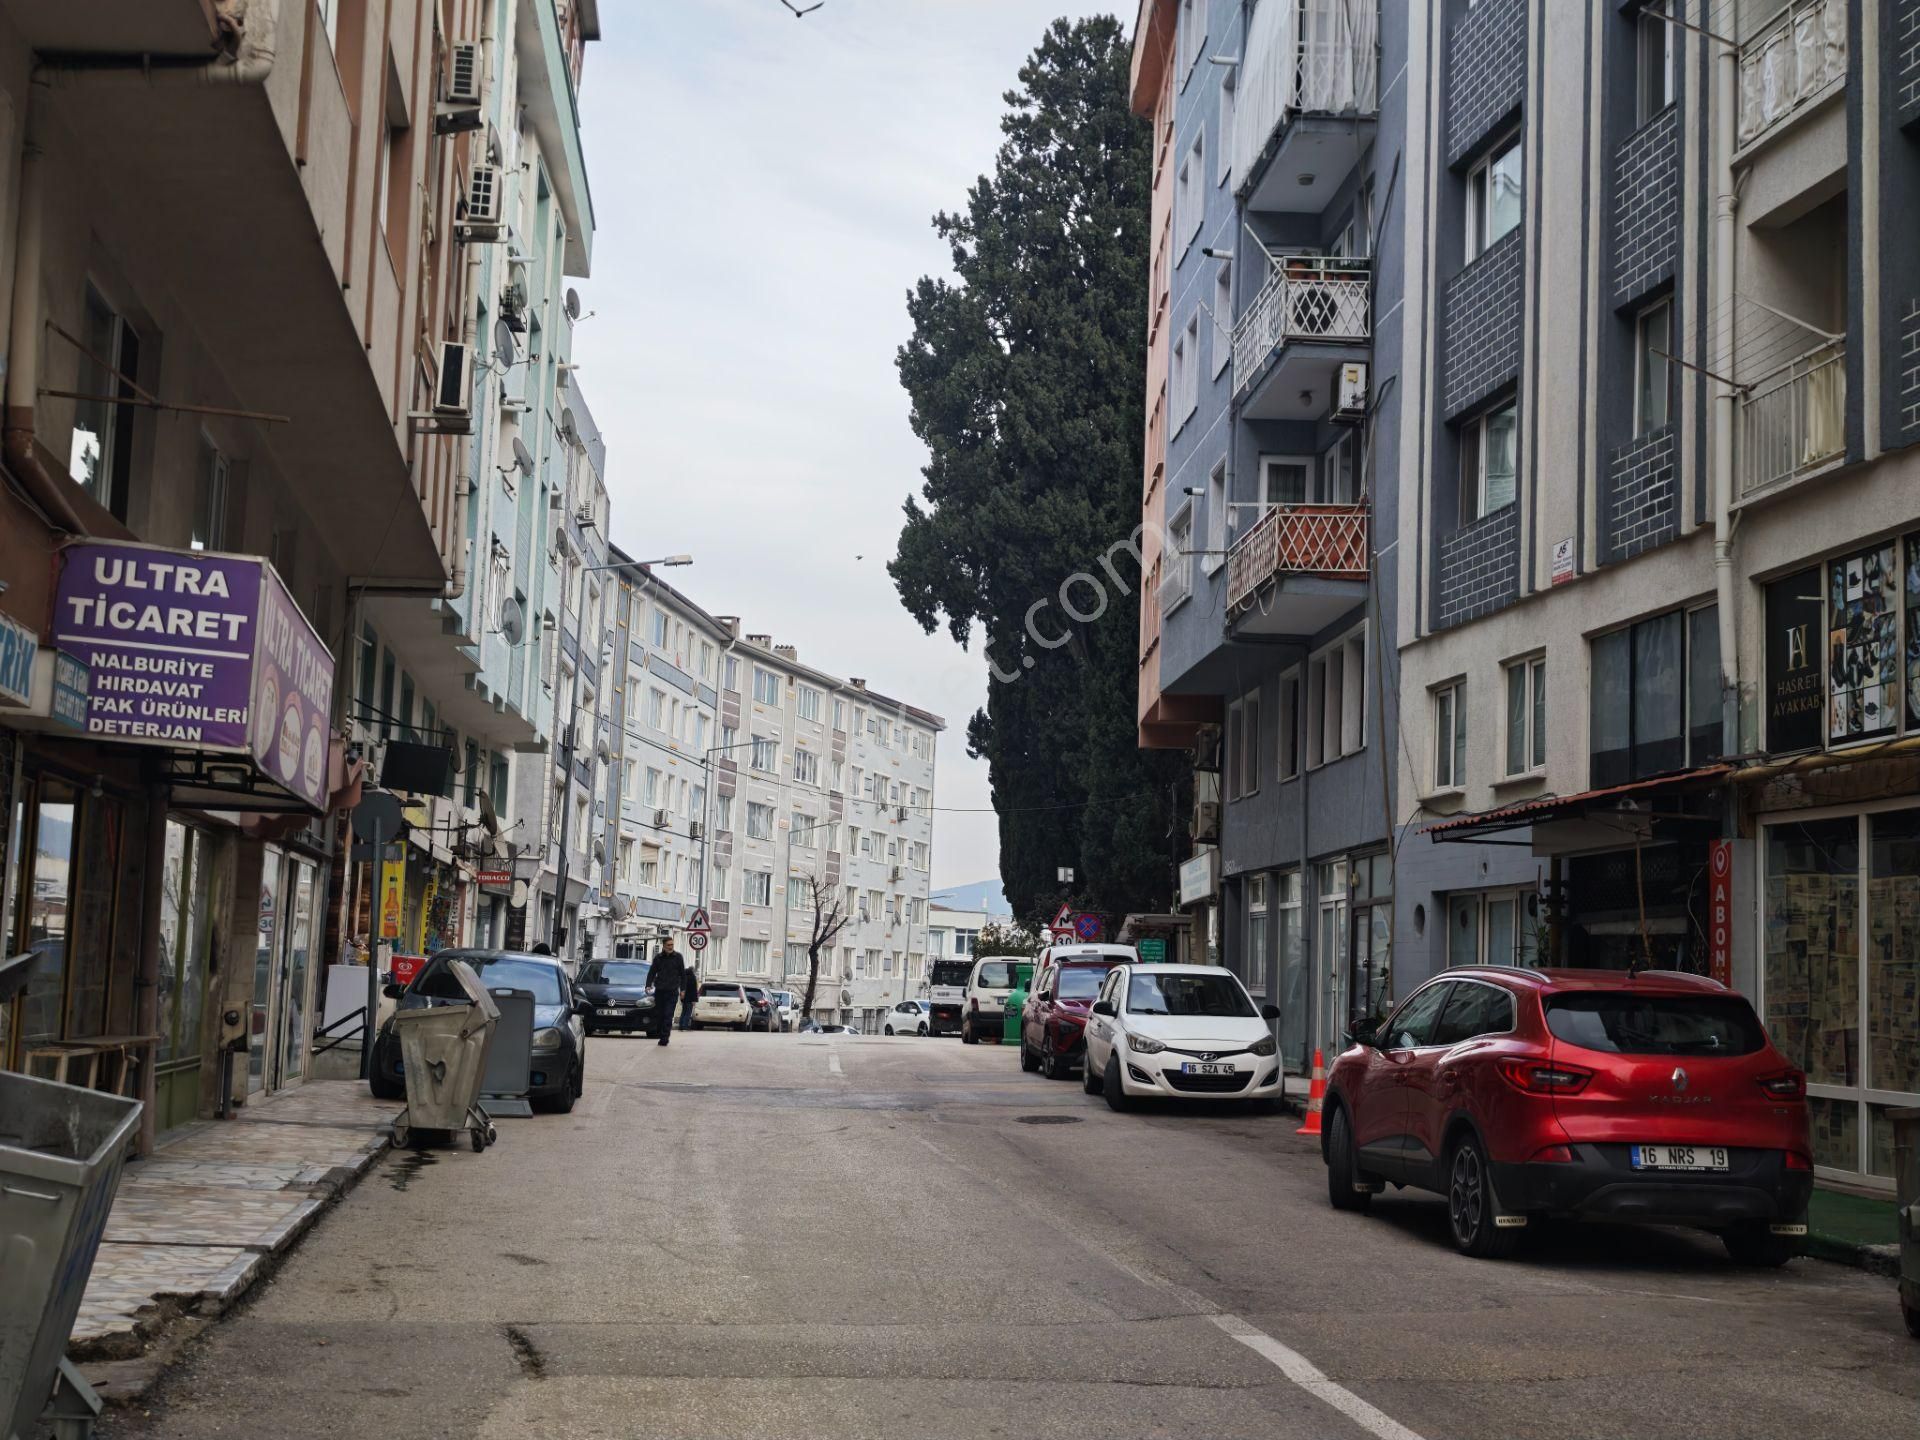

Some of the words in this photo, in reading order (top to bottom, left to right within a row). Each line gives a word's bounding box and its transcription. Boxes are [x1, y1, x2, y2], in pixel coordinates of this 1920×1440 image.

[95, 557, 230, 598] ULTRA
[68, 593, 248, 641] TİCARET
[91, 652, 214, 678] NALBURİYE
[264, 590, 294, 678] ULTRA
[294, 631, 333, 718] TİCARET
[97, 675, 203, 698] HIRDAVAT
[1777, 674, 1819, 696] HASRET
[87, 696, 133, 714] FAK
[141, 699, 248, 724] ÜRÜNLERİ
[89, 718, 201, 741] DETERJAN
[692, 937, 704, 946] 30
[1188, 1065, 1196, 1073] 16
[1202, 1065, 1218, 1074] SZA
[1223, 1065, 1233, 1074] 45
[1641, 1147, 1656, 1163] 16
[1668, 1148, 1694, 1164] NRS
[1710, 1149, 1725, 1165] 19
